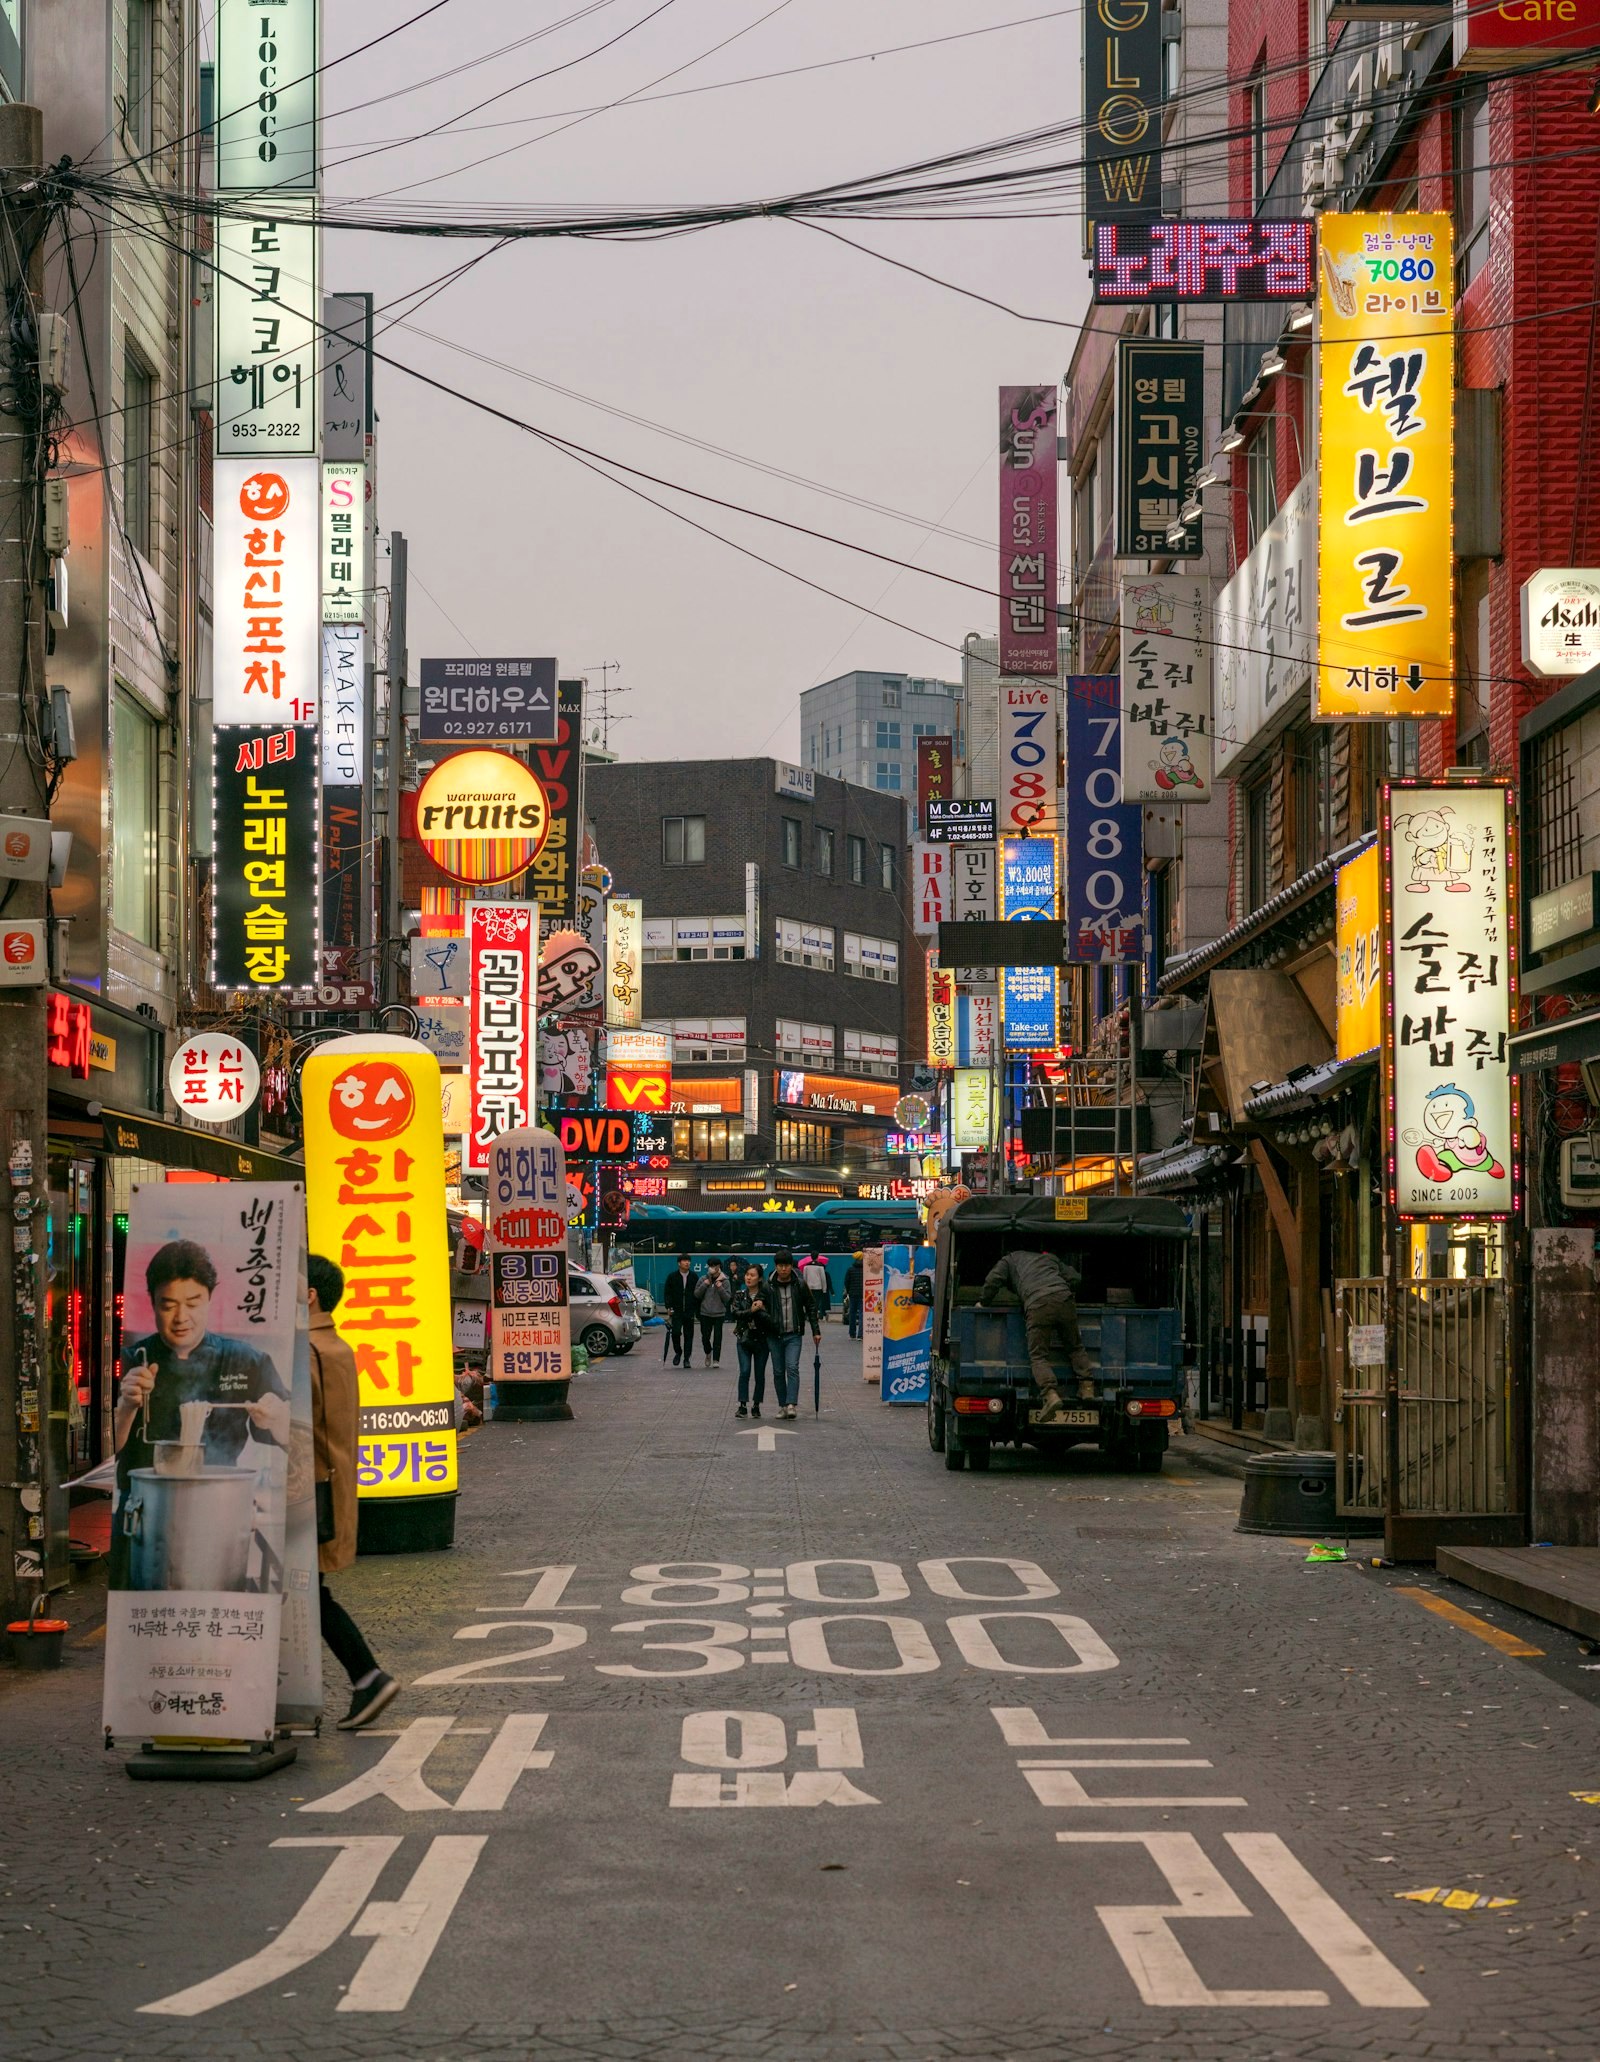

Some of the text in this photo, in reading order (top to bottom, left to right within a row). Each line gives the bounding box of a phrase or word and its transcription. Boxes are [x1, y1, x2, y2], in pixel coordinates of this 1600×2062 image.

[1498, 0, 1577, 21] Cafe
[1098, 0, 1151, 202] GLOW
[1099, 224, 1311, 295] 노래주점
[1365, 257, 1434, 282] 7080
[251, 220, 281, 355] 로코코
[1366, 291, 1446, 314] 라이브
[1135, 378, 1186, 403] 영림
[231, 423, 301, 437] 953-2322
[1137, 414, 1181, 531] 고시텔
[1346, 345, 1426, 627] 쉘브르
[331, 513, 354, 605] 필라테스
[242, 527, 287, 700] 한신포차
[1564, 632, 1583, 647] 生
[445, 663, 532, 677] 프리미엄 원룸텔
[1003, 660, 1053, 671] T.921-2167
[1128, 639, 1194, 690] 술줘
[1346, 666, 1399, 692] 지하
[289, 697, 316, 721] 1F
[424, 687, 551, 714] 원더하우스
[1007, 690, 1049, 705] Live
[443, 722, 532, 735] 02.927.6171
[1129, 698, 1205, 737] 밥줘
[234, 729, 296, 773] 시티
[1009, 711, 1047, 827] 7080
[446, 792, 517, 802] warawara
[1139, 790, 1160, 799] SINCE
[1085, 717, 1124, 910] 7080
[929, 827, 943, 839] 4F
[242, 776, 291, 984] 노래연습장
[921, 853, 943, 924] BAR
[1481, 825, 1499, 943] 퓨전민속주점
[1400, 912, 1499, 995] 술줘
[932, 971, 953, 1057] 노래연습장
[1009, 1022, 1050, 1032] Take-out
[1400, 1005, 1507, 1071] 밥줘
[182, 1047, 244, 1075] 한신
[182, 1077, 245, 1104] 포차
[612, 1077, 667, 1106] VR
[560, 1117, 631, 1154] DVD
[886, 1134, 942, 1155] 라이브
[496, 1146, 559, 1204] 영화관
[1410, 1187, 1479, 1203] SINCE 2003
[500, 1218, 561, 1240] Full HD
[237, 1198, 273, 1323] 백종원
[334, 1147, 425, 1398] 한신포차
[502, 1279, 560, 1304] 진동의자
[502, 1310, 561, 1328] HD프로젝터
[503, 1351, 562, 1375] 흡연가능
[889, 1372, 927, 1396] Cass
[1063, 1411, 1092, 1423] 7551
[128, 1621, 168, 1638] 가득한
[172, 1621, 201, 1638] 우동
[206, 1621, 222, 1638] 한
[167, 1692, 225, 1715] 역전우동
